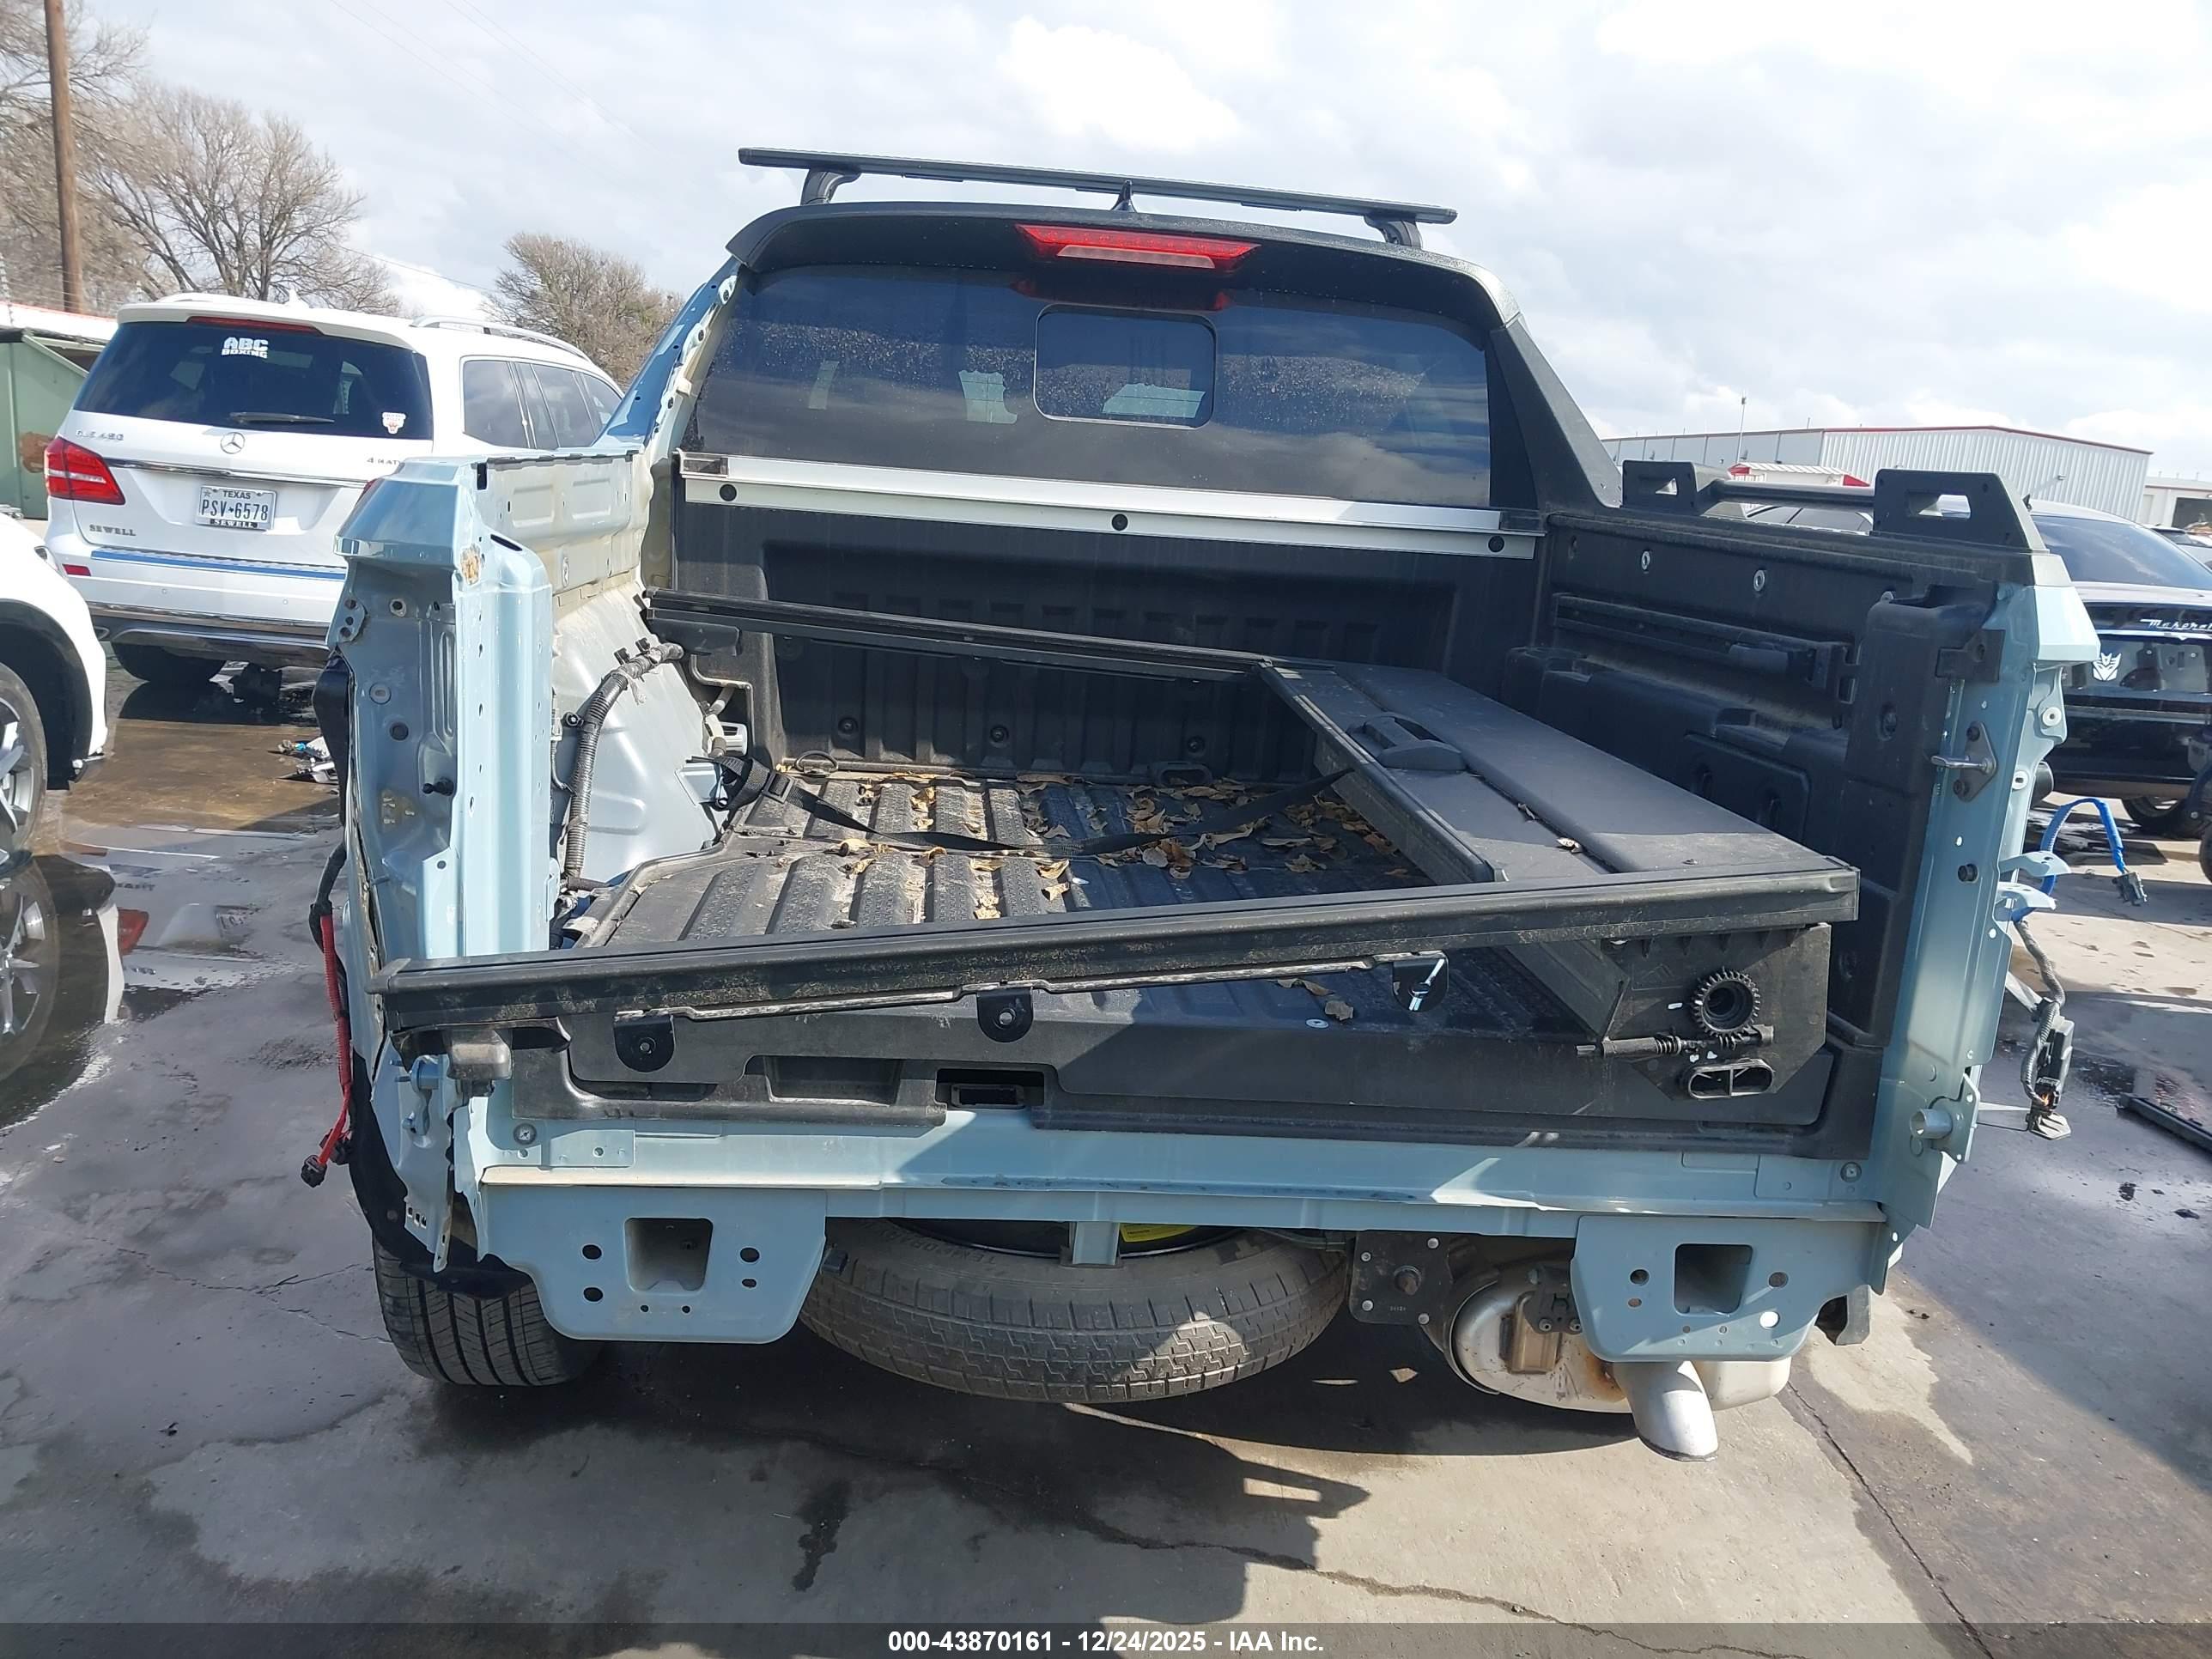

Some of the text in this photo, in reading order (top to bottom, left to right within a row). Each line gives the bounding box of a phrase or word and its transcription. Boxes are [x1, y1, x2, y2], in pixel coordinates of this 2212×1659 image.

[223, 337, 269, 351] ABC
[221, 349, 268, 359] BOXING
[367, 457, 400, 465] 4MAT
[223, 490, 252, 499] TEXAS
[201, 499, 269, 521] PSV 6578
[214, 519, 255, 529] SEWELL
[88, 524, 137, 537] SEWELL
